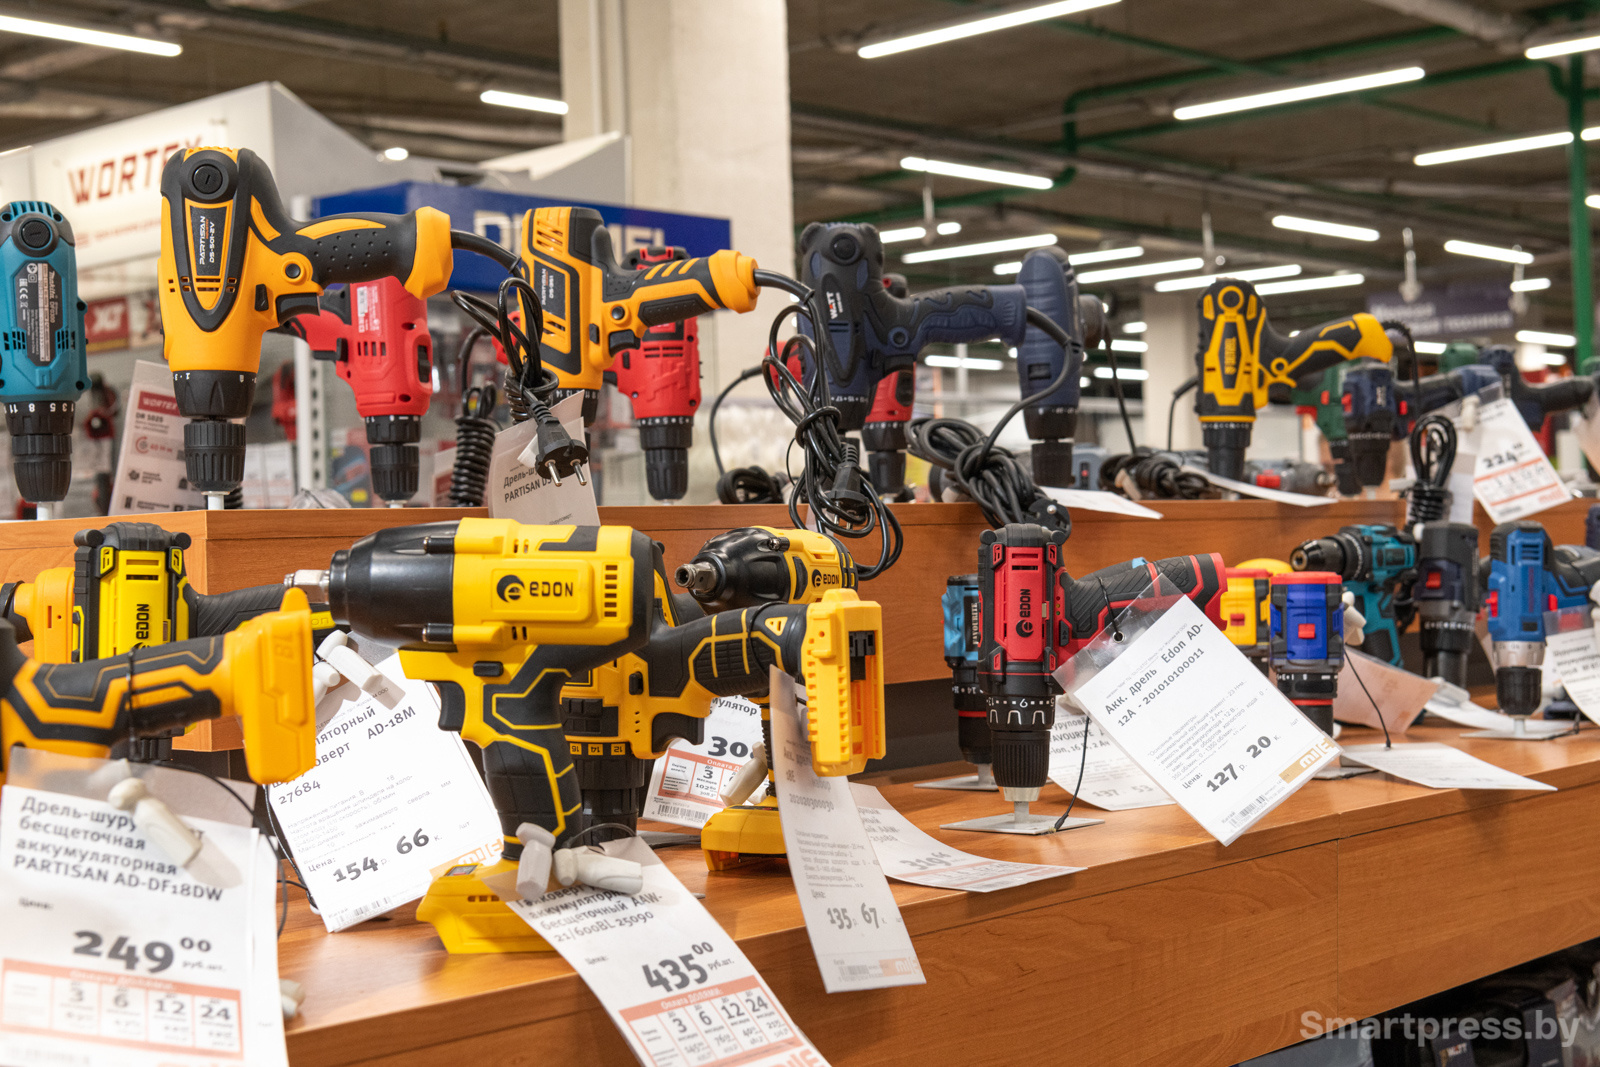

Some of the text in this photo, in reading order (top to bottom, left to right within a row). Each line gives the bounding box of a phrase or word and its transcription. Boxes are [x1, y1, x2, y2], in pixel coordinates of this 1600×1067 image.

[199, 216, 207, 265] PARTISAN
[504, 480, 541, 503] PARTISAN
[1105, 624, 1203, 714] Акк. дрель Edon AD-
[1143, 648, 1204, 704] 201010100011
[368, 706, 415, 739] AD-18M
[712, 698, 757, 716] мулятор
[316, 706, 375, 744] ляторный
[708, 736, 754, 759] 30
[1207, 763, 1238, 792] 127
[1246, 736, 1271, 758] 20
[703, 770, 713, 779] 3
[1182, 773, 1202, 789] Цена:
[279, 781, 320, 804] 27684
[19, 816, 146, 851] бесщеточная
[16, 839, 178, 875] аккумуляторная
[308, 858, 335, 872] Цена:
[333, 857, 378, 882] 154
[397, 828, 429, 854] 66
[901, 855, 946, 871] 319
[13, 854, 224, 902] PARTISAN AD-DF18DW
[528, 888, 628, 919] аккумуляторн
[540, 893, 663, 930] бесщеточный AAW-
[827, 907, 852, 930] 135
[861, 902, 880, 929] 67
[553, 912, 654, 942] 21/600BL 25090
[73, 930, 212, 973] 249 00
[643, 941, 715, 993] 435 00
[155, 999, 186, 1016] 12
[201, 1004, 231, 1021] 24
[672, 995, 769, 1034] 3 6 12 24
